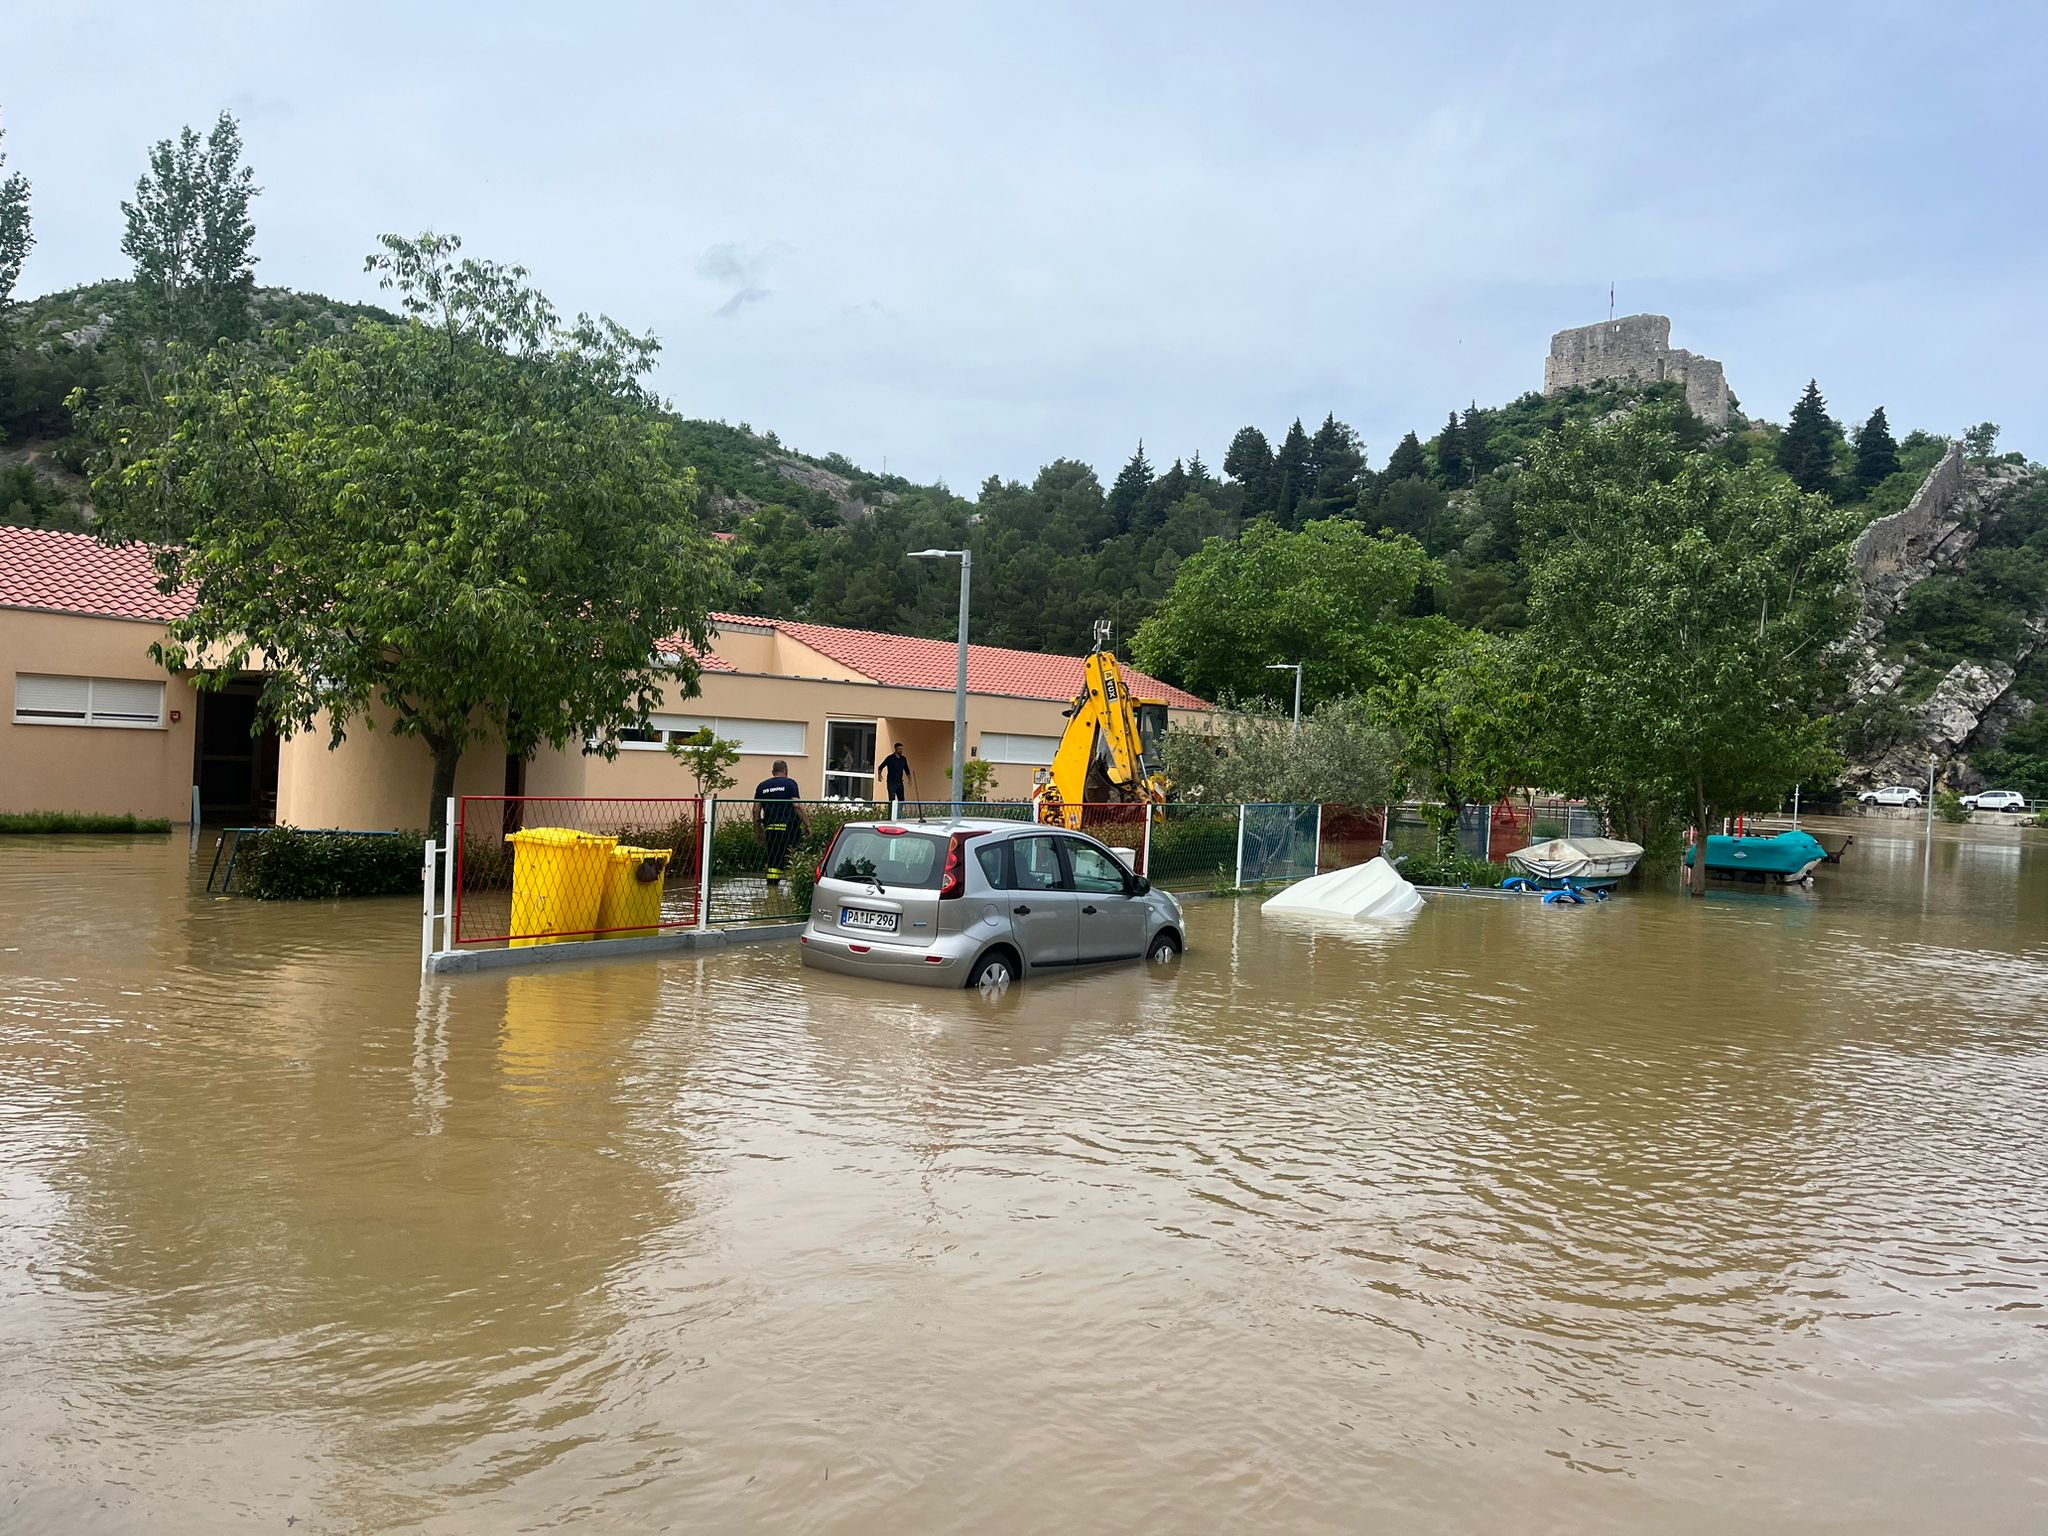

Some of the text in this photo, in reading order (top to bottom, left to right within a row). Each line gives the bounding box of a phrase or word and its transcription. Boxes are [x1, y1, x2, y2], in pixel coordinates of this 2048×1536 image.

[848, 911, 894, 926] PA IF 296
